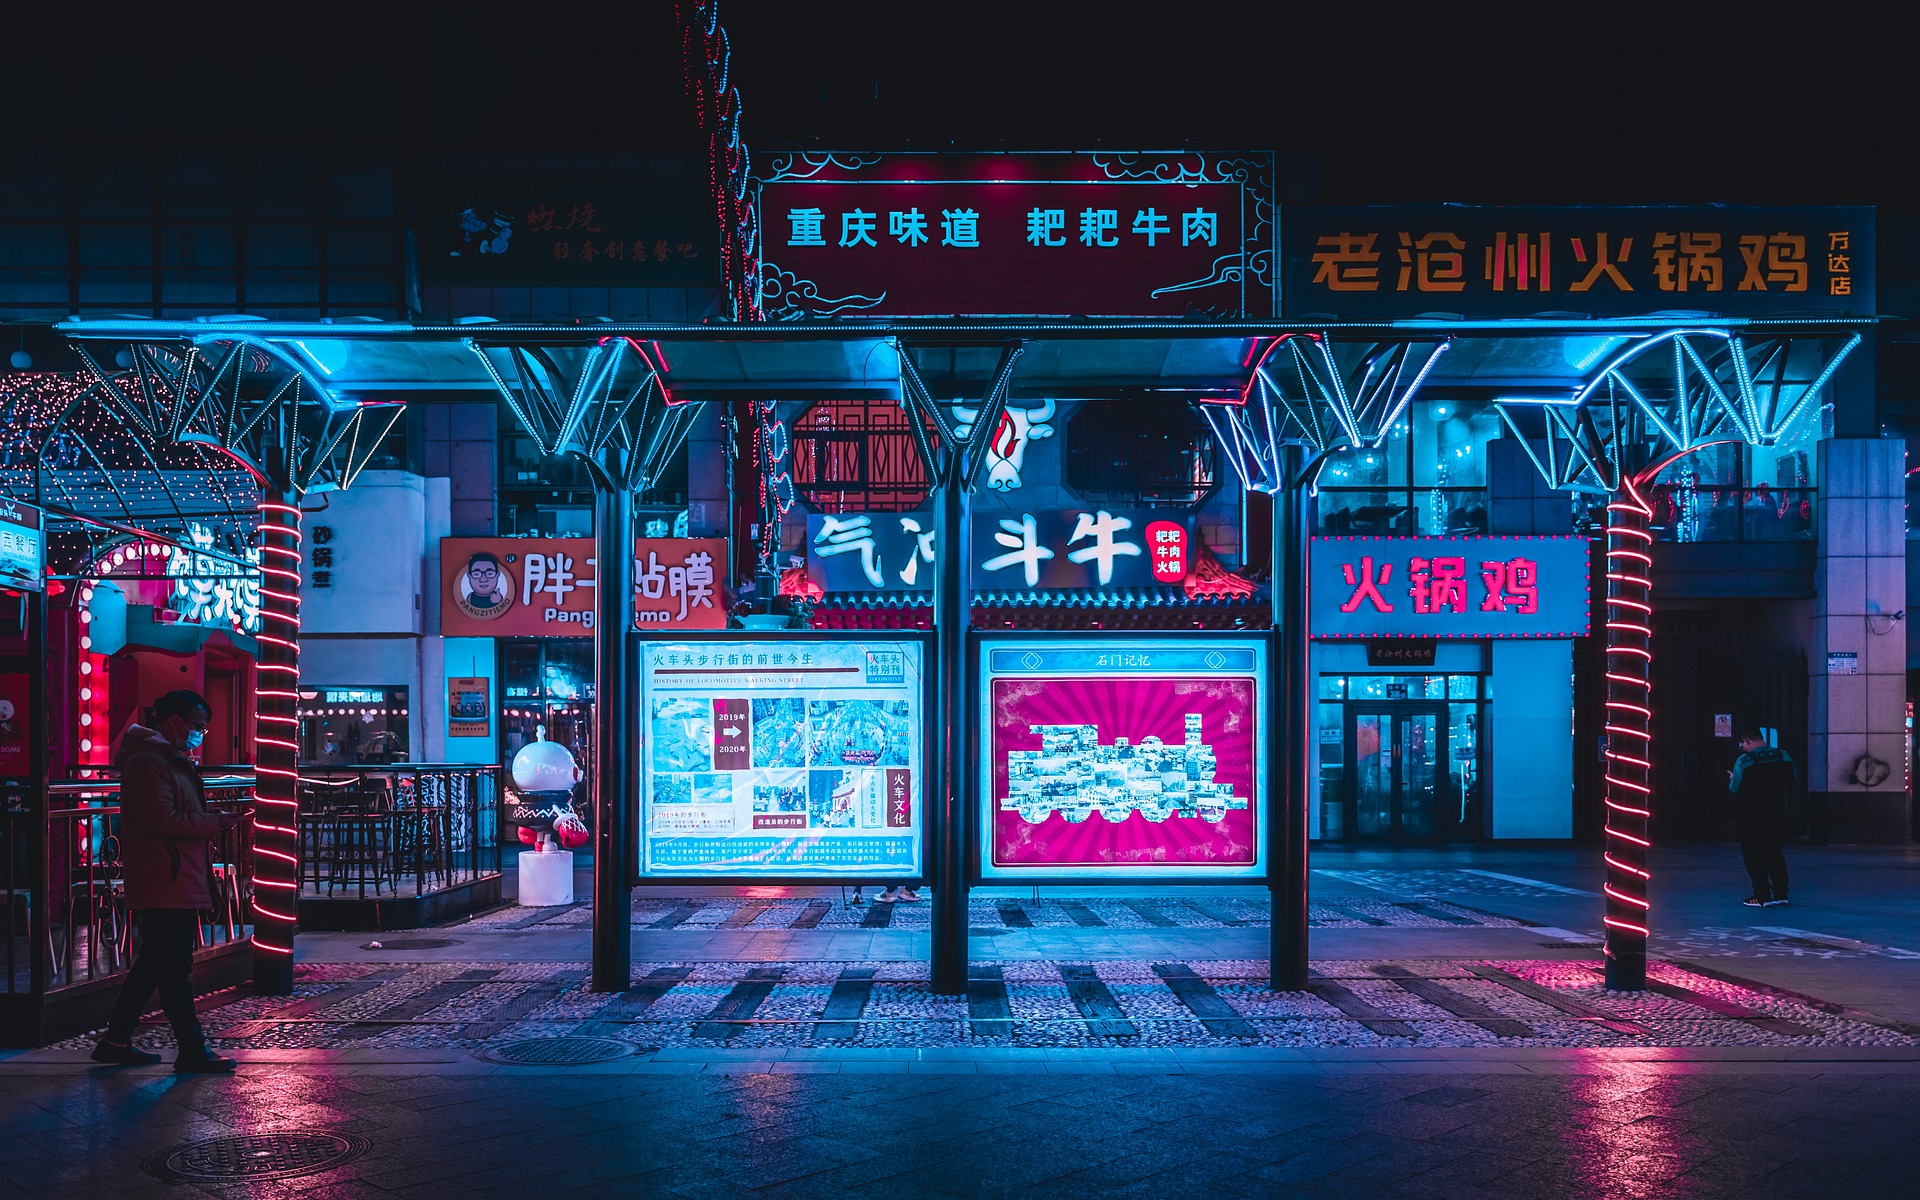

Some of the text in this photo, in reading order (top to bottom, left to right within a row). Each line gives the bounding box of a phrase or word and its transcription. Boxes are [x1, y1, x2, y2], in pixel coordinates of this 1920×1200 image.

[787, 207, 1218, 248] 重庆味道 耙耙牛肉
[554, 240, 697, 262] 轻奢创意餐吧
[1311, 232, 1808, 292] 老沧州火锅鸡
[1828, 231, 1851, 296] 万达店
[1156, 545, 1181, 558] 牛肉
[1156, 560, 1181, 574] 火锅
[1340, 555, 1539, 615] 火锅鸡
[460, 598, 510, 616] PANGZITIEMO
[653, 653, 814, 667] 火车头步行街的前世今生
[869, 654, 900, 664] 火车头
[1096, 654, 1151, 667] 石门记忆
[869, 664, 900, 675] 特别刊
[719, 713, 746, 722] 2019年
[719, 745, 747, 753] 2020年
[894, 773, 906, 825] 火车文化
[758, 818, 803, 826] 改造后的步行街
